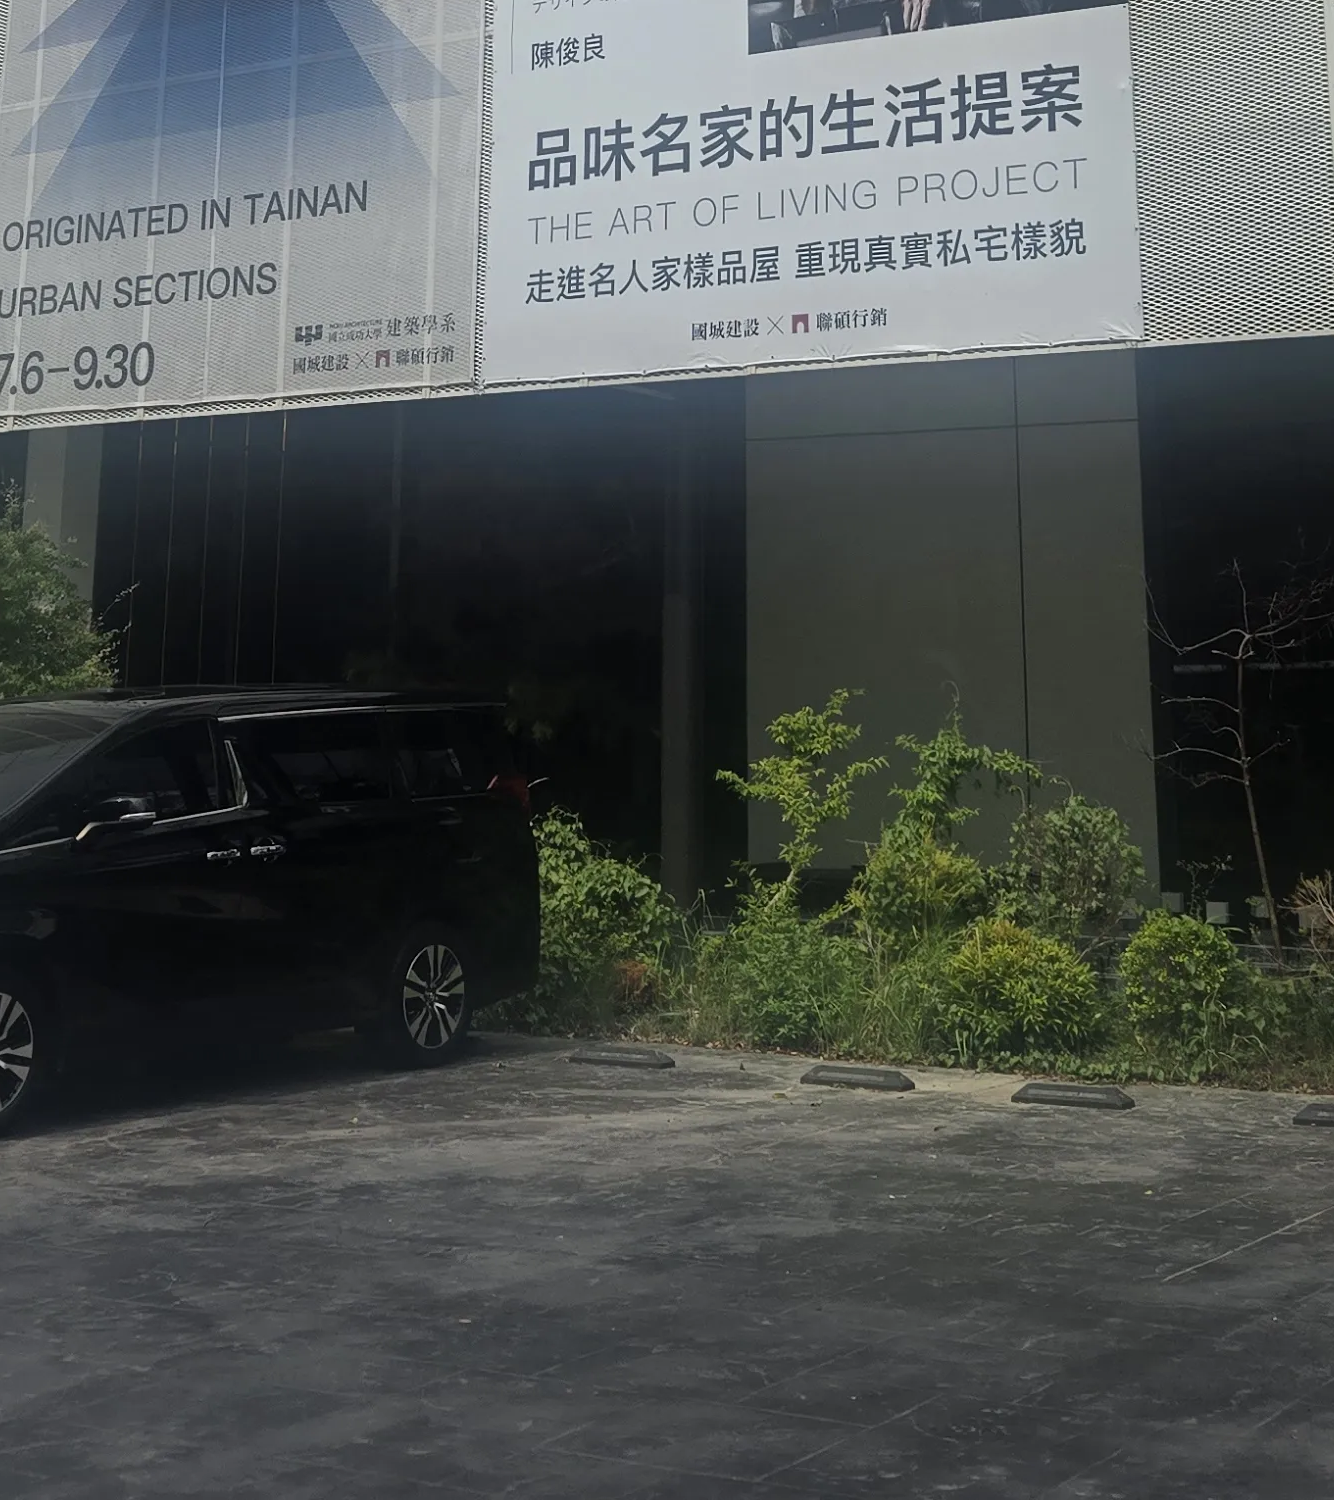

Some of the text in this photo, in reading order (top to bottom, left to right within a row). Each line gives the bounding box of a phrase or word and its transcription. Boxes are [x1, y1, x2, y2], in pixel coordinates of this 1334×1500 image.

[531, 33, 605, 71] 陳俊良
[527, 63, 1084, 190] 品味名家的生活提案
[1, 180, 368, 252] ORIGINATED IN TAINAN
[528, 157, 1088, 245] THE ART OF LIVING PROJECT
[114, 262, 277, 309] SECTIONS
[525, 217, 1087, 304] 走進名人家樣品屋 重現真實私宅樣貌
[691, 318, 759, 341] 國城建設
[816, 307, 888, 332] 聯碩行銷
[293, 354, 349, 374] 國城建設
